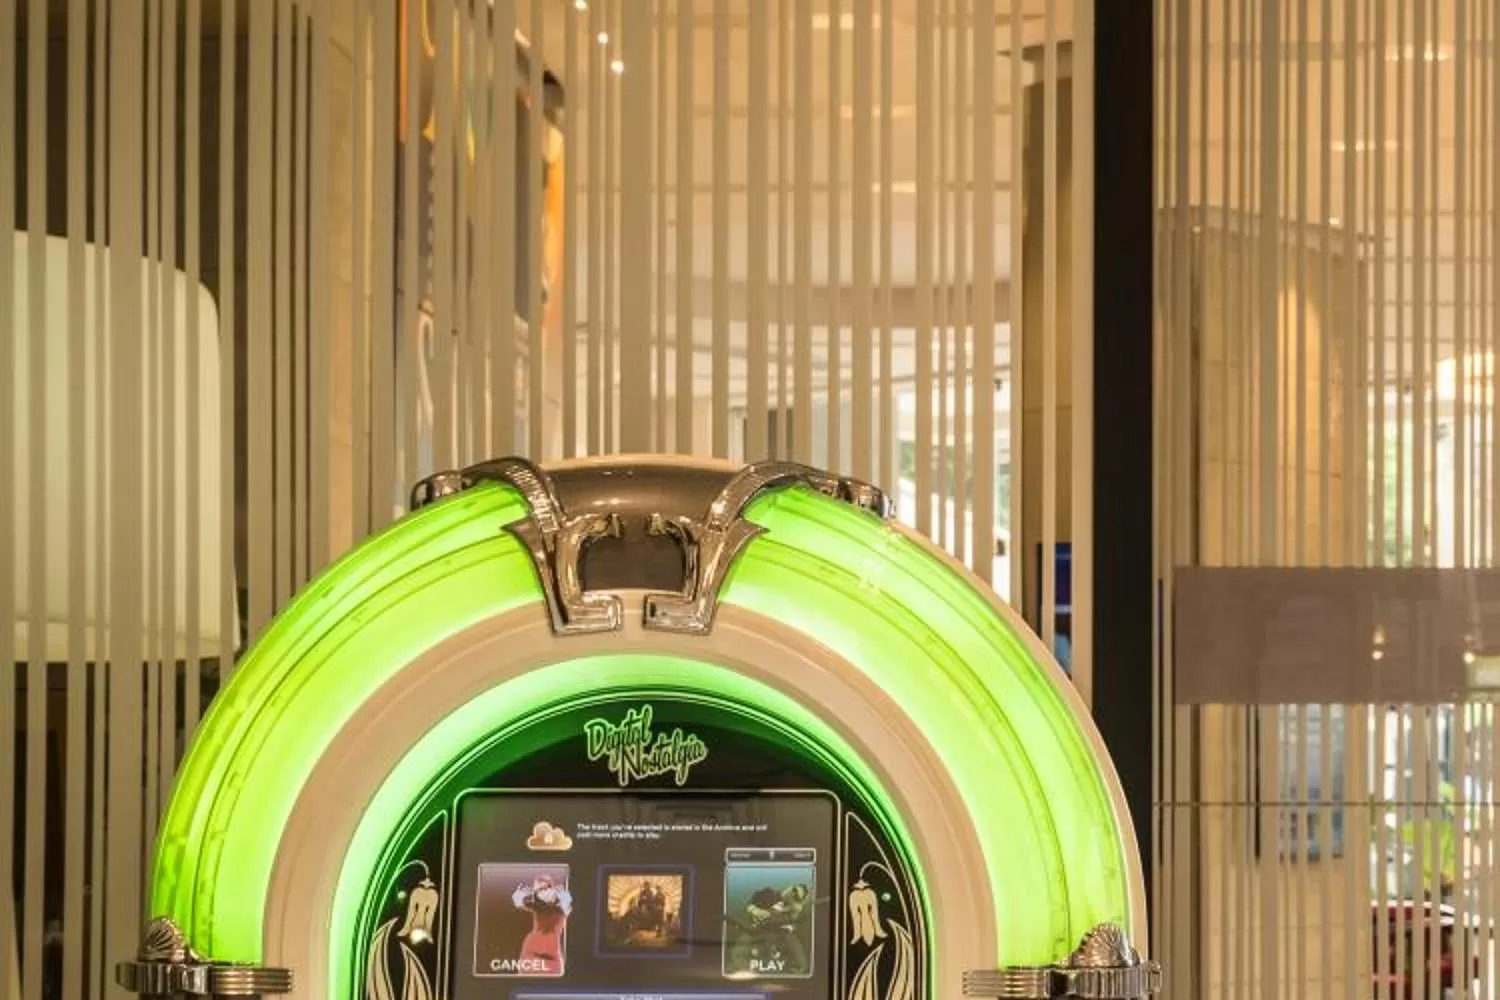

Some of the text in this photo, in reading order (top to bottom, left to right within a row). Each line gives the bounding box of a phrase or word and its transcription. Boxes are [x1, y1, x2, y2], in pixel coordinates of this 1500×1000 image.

[584, 704, 653, 772] Digital
[618, 728, 708, 786] Nostalgia
[490, 959, 552, 971] CANCEL
[749, 959, 785, 971] PLAY
